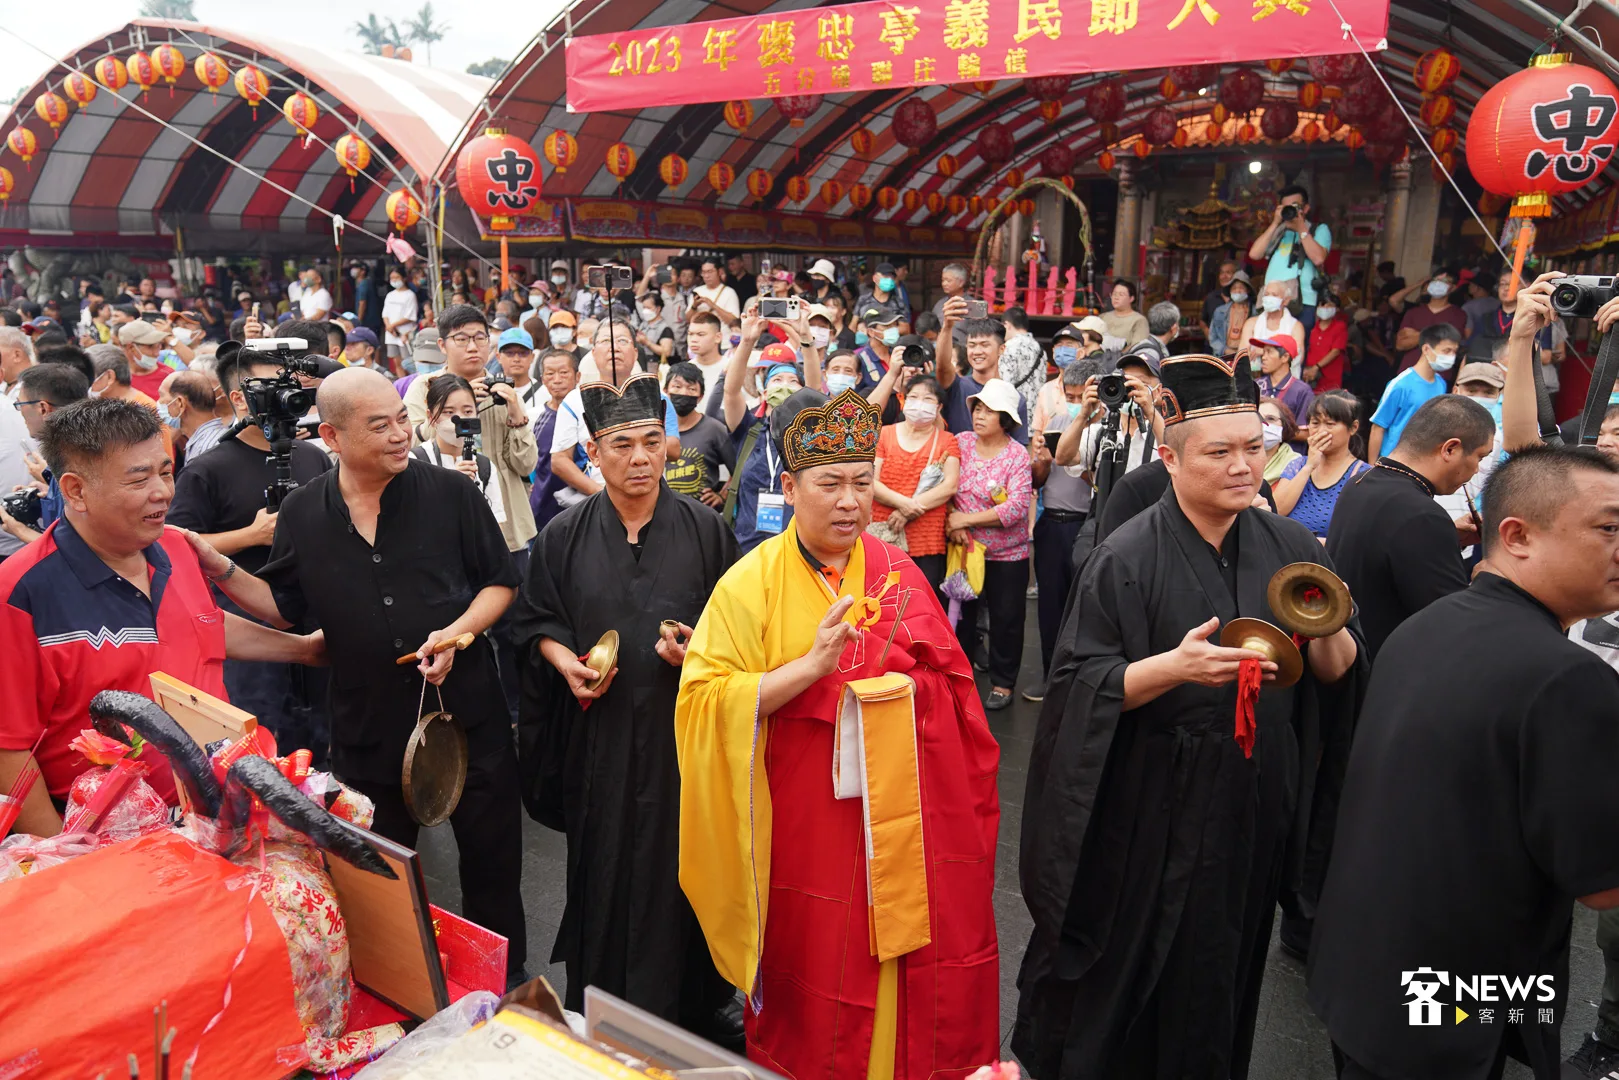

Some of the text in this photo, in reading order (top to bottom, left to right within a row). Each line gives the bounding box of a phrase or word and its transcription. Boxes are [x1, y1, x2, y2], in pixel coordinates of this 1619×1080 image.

[608, 36, 682, 76] 2023
[1524, 83, 1618, 183] 忠
[486, 148, 538, 209] 忠
